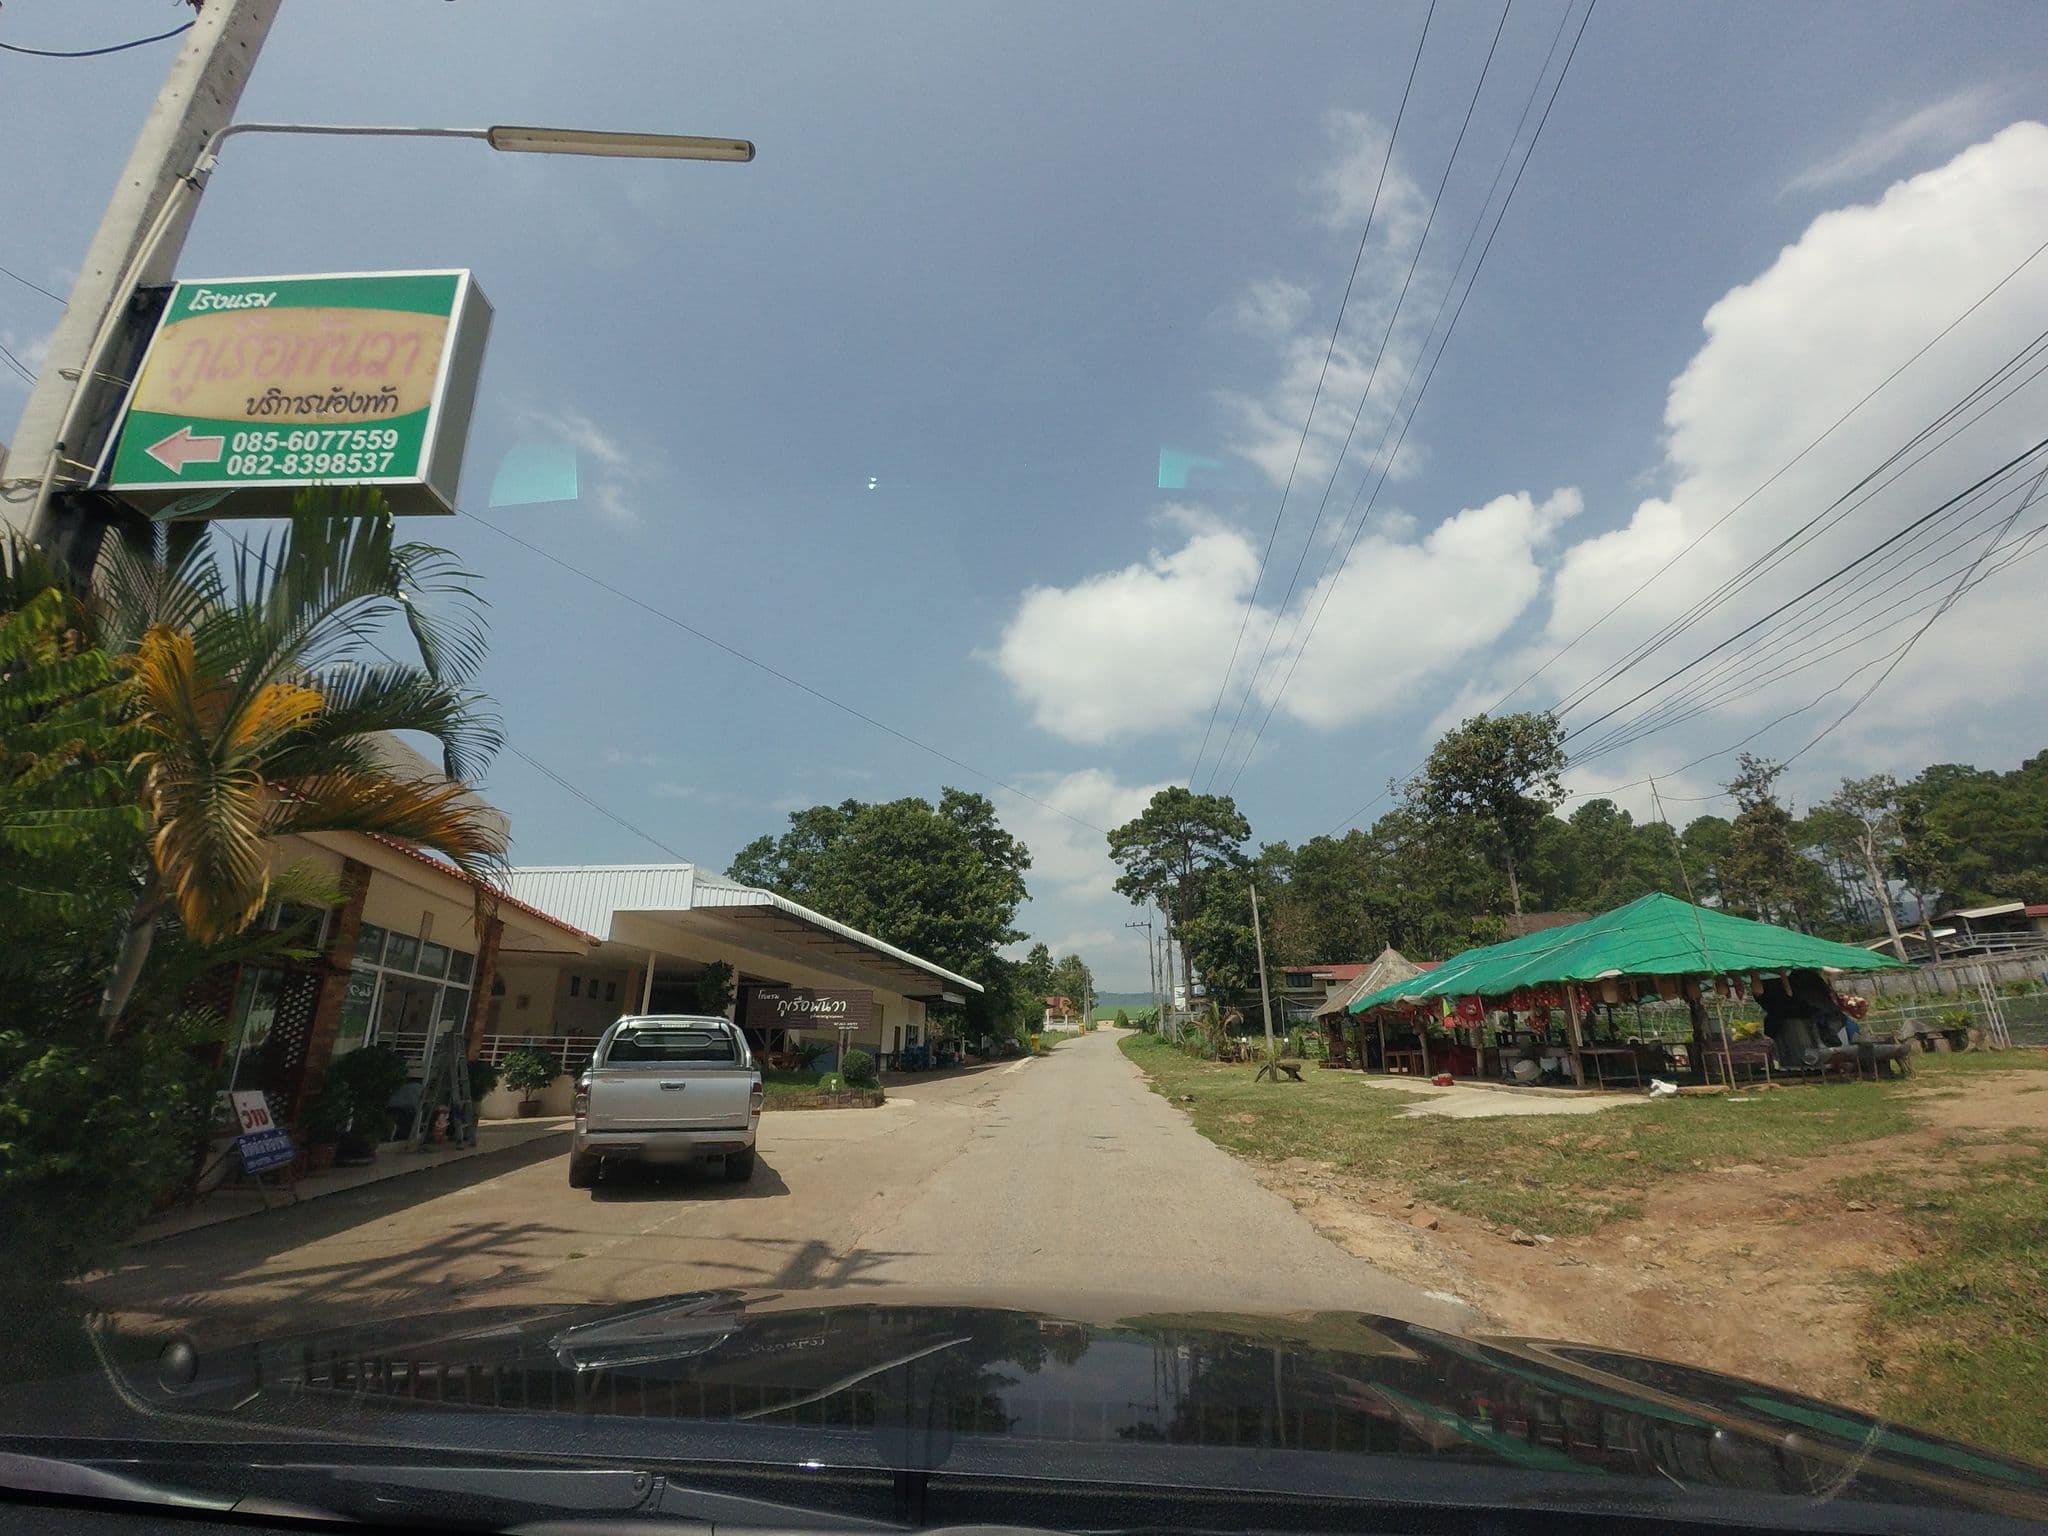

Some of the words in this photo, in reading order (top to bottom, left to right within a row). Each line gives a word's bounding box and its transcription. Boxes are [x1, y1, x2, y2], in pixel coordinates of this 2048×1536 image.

[188, 288, 277, 312] โรงแรม
[246, 386, 400, 417] บริการห้องพัก
[231, 429, 400, 453] 085-6077559
[226, 451, 395, 476] 082-8398537
[776, 995, 847, 1017] ภูเรือพันวา
